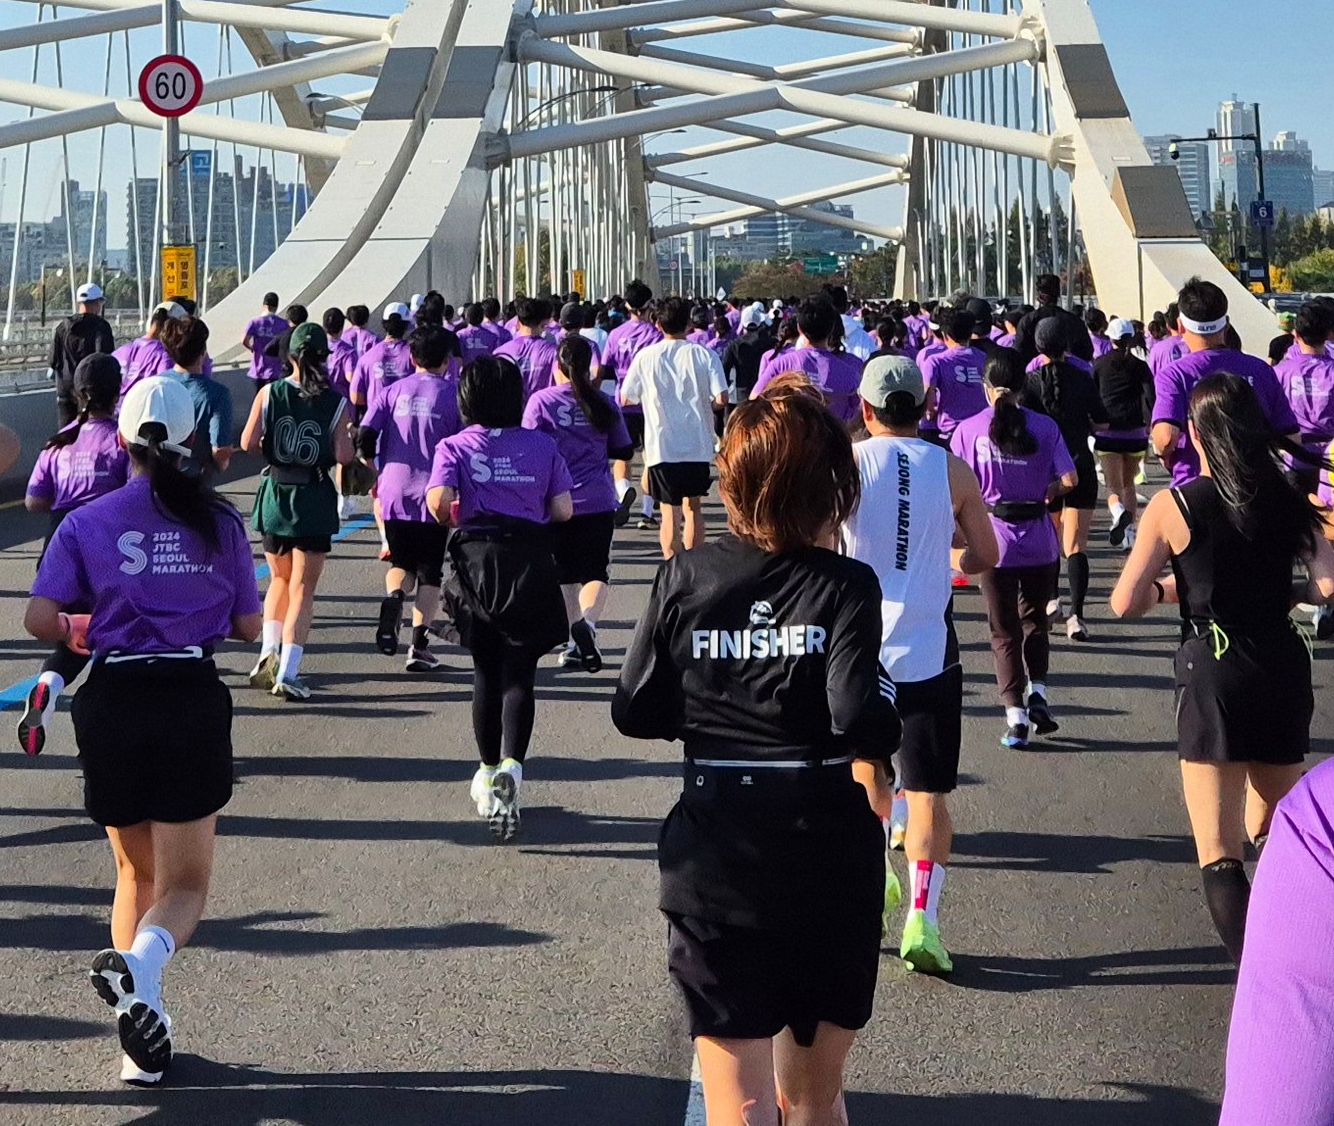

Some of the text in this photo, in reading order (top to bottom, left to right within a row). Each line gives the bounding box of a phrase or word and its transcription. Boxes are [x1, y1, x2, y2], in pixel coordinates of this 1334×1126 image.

[155, 72, 186, 100] 60
[1259, 206, 1268, 218] 6
[274, 415, 322, 465] 06
[895, 452, 910, 571] SEJONG MARATHON
[152, 531, 181, 542] 2024
[152, 542, 181, 553] JTBC
[152, 553, 190, 564] SEOUL
[692, 624, 827, 660] FINISHER
